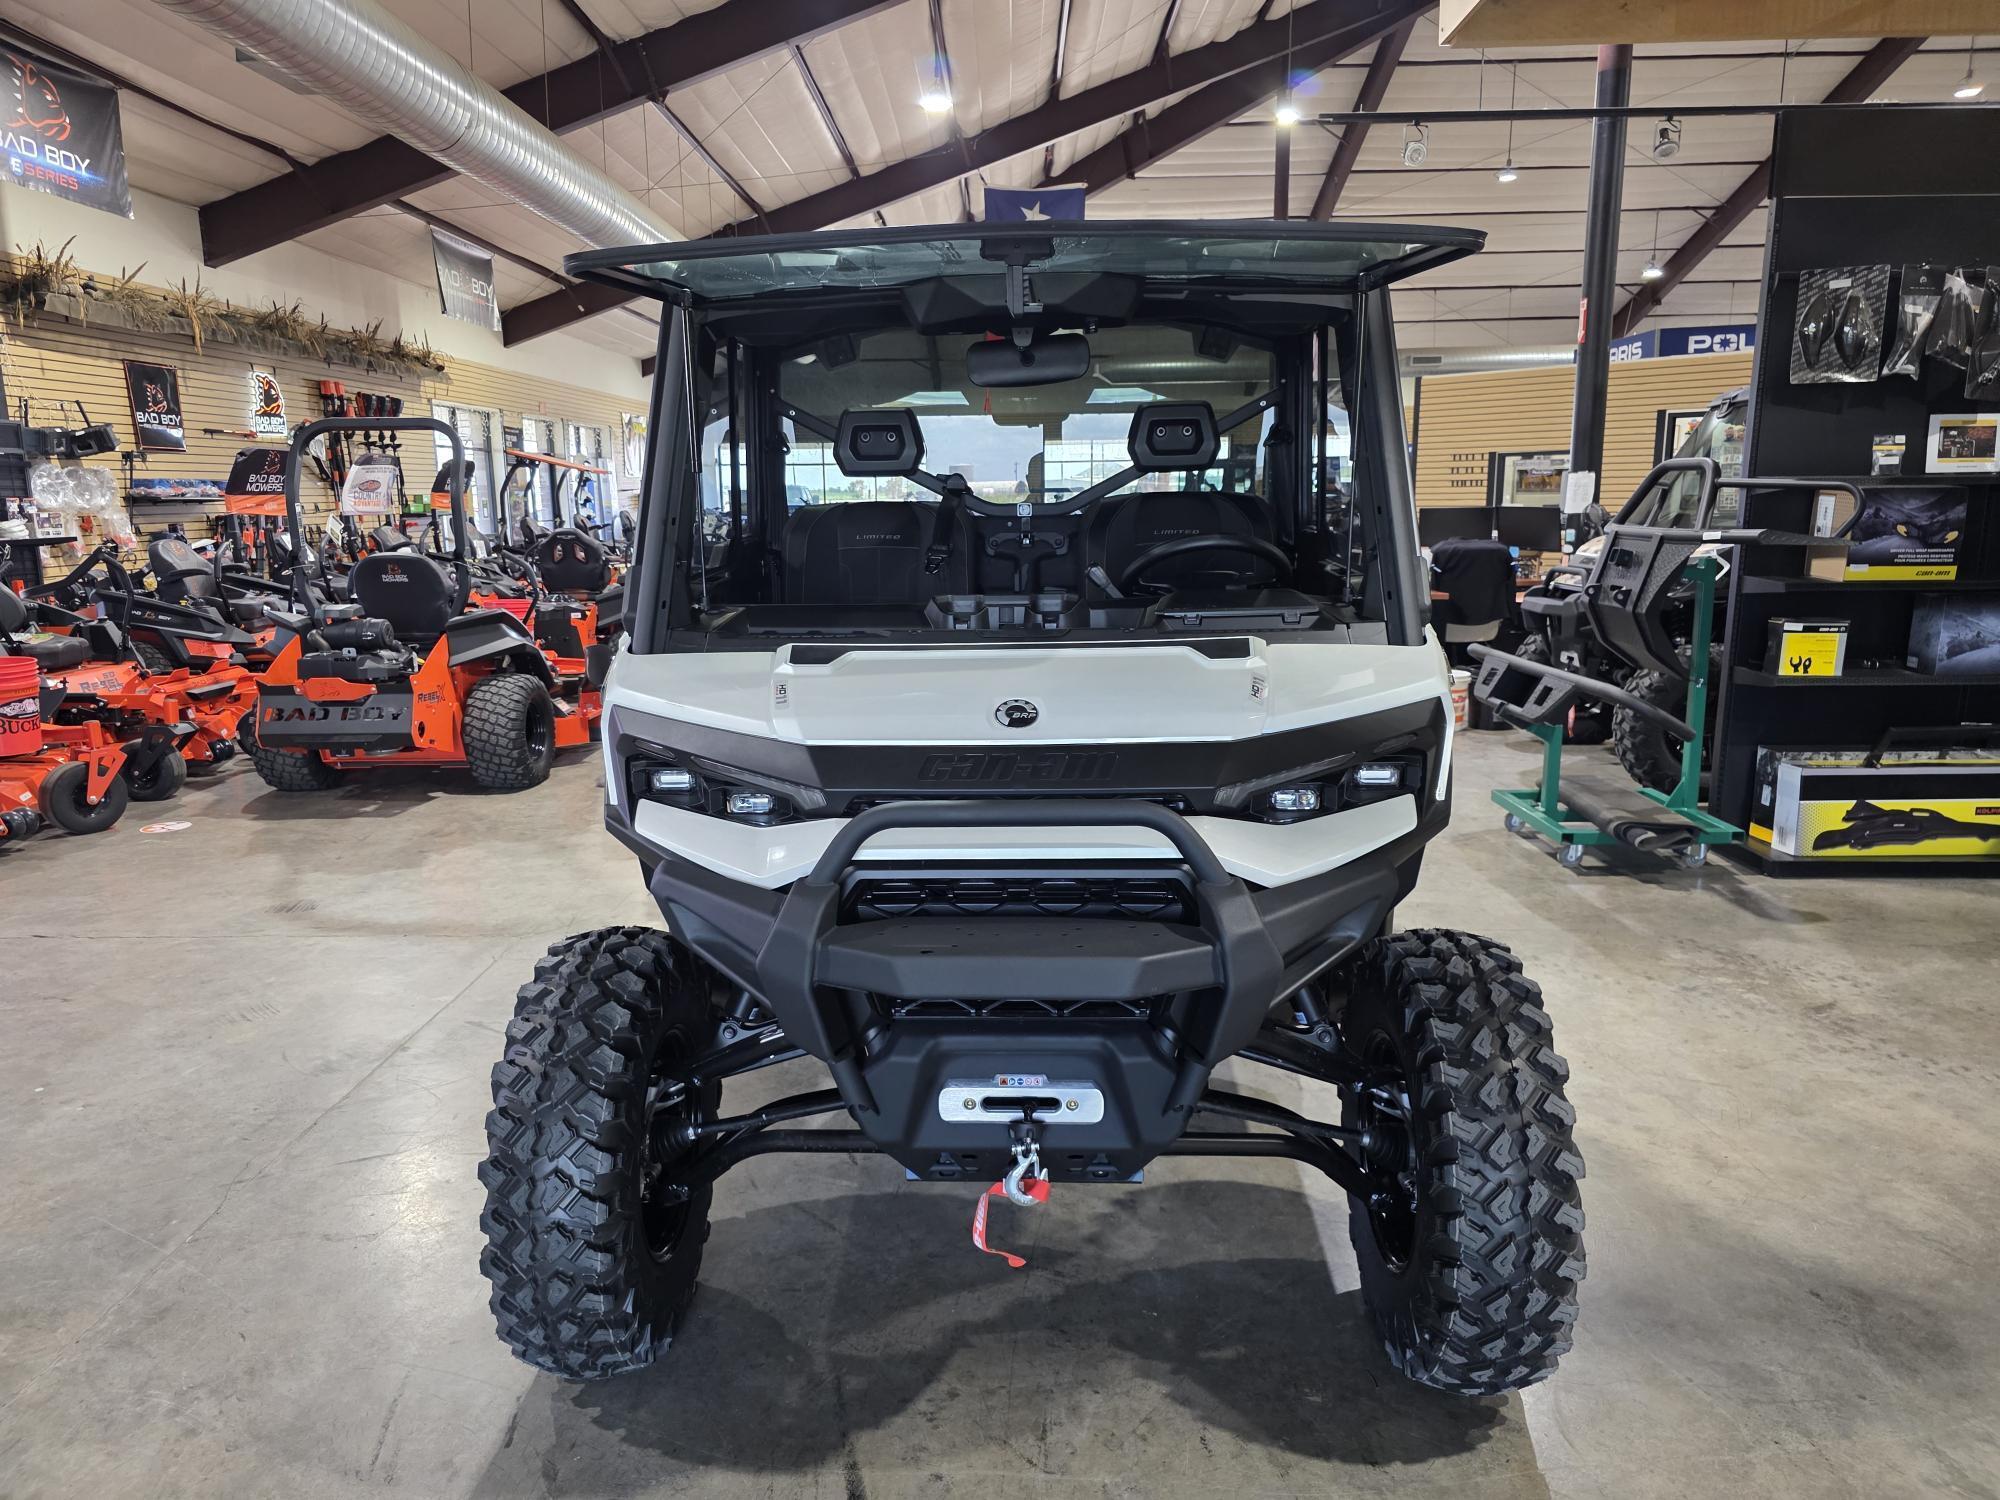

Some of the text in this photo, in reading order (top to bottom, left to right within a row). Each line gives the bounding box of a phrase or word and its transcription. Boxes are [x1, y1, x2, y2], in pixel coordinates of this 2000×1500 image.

[0, 130, 91, 177] AD BOY
[23, 163, 79, 191] SERIES
[471, 278, 494, 302] BOY
[1608, 341, 1643, 361] ARIS
[136, 411, 181, 426] BAD BOY
[255, 415, 284, 425] BAD BOY
[256, 423, 286, 434] MOWERS
[249, 474, 286, 483] BAD BOY
[246, 483, 284, 492] MOWERS
[264, 706, 408, 722] BAD BOY
[918, 752, 1120, 782] can-am
